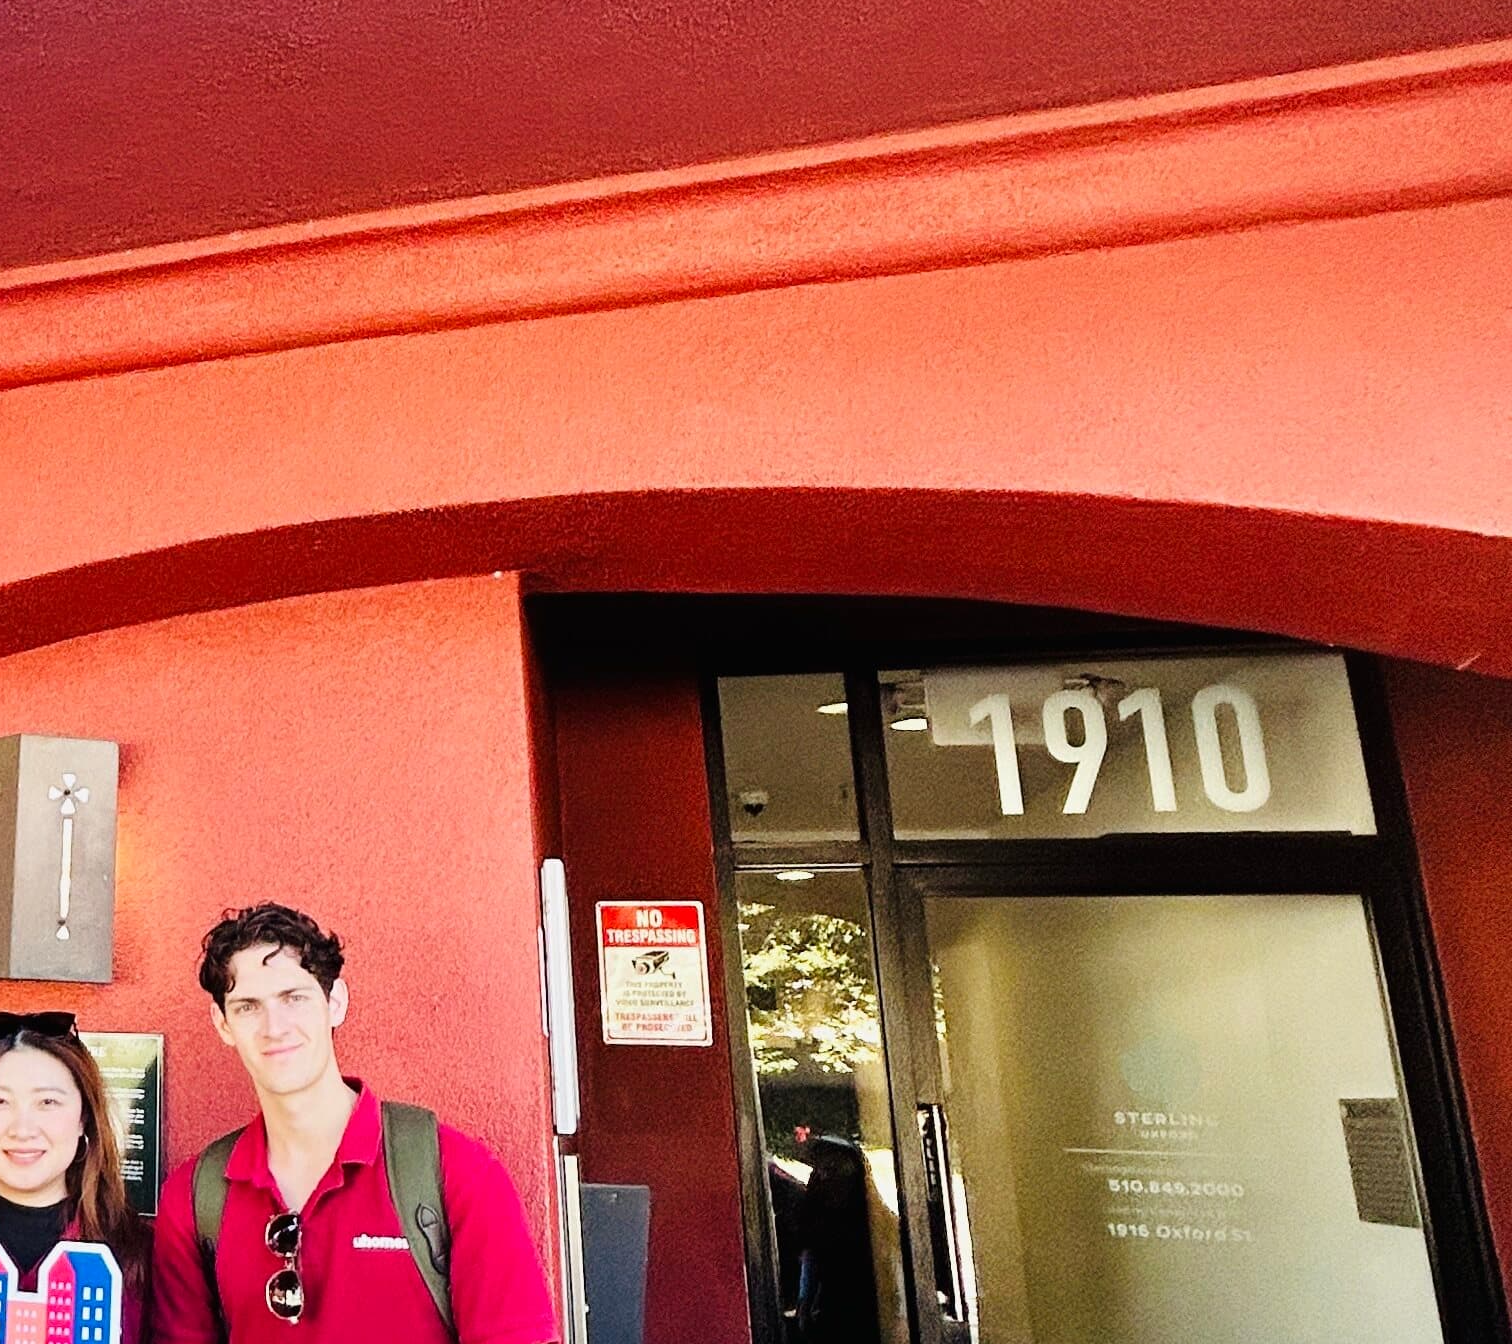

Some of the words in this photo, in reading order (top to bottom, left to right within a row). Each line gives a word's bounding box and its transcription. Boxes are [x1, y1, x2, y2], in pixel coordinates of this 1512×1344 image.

[968, 684, 1272, 816] 1910
[635, 909, 663, 929] NO
[605, 928, 697, 944] TRESPASSING
